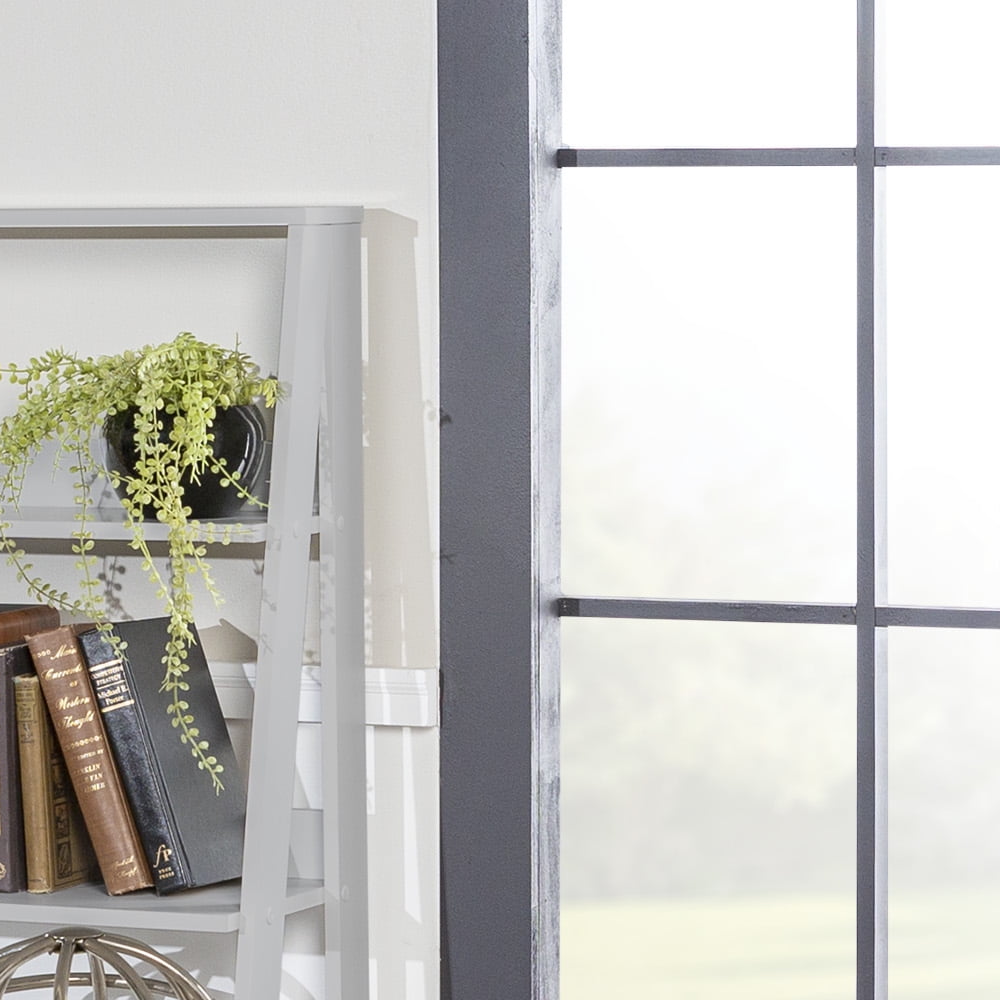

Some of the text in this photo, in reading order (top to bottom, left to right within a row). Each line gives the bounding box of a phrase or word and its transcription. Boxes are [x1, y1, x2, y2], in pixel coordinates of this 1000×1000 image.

[50, 644, 77, 660] Main
[41, 663, 83, 681] Currents
[55, 696, 90, 710] Western
[60, 710, 95, 729] Thought
